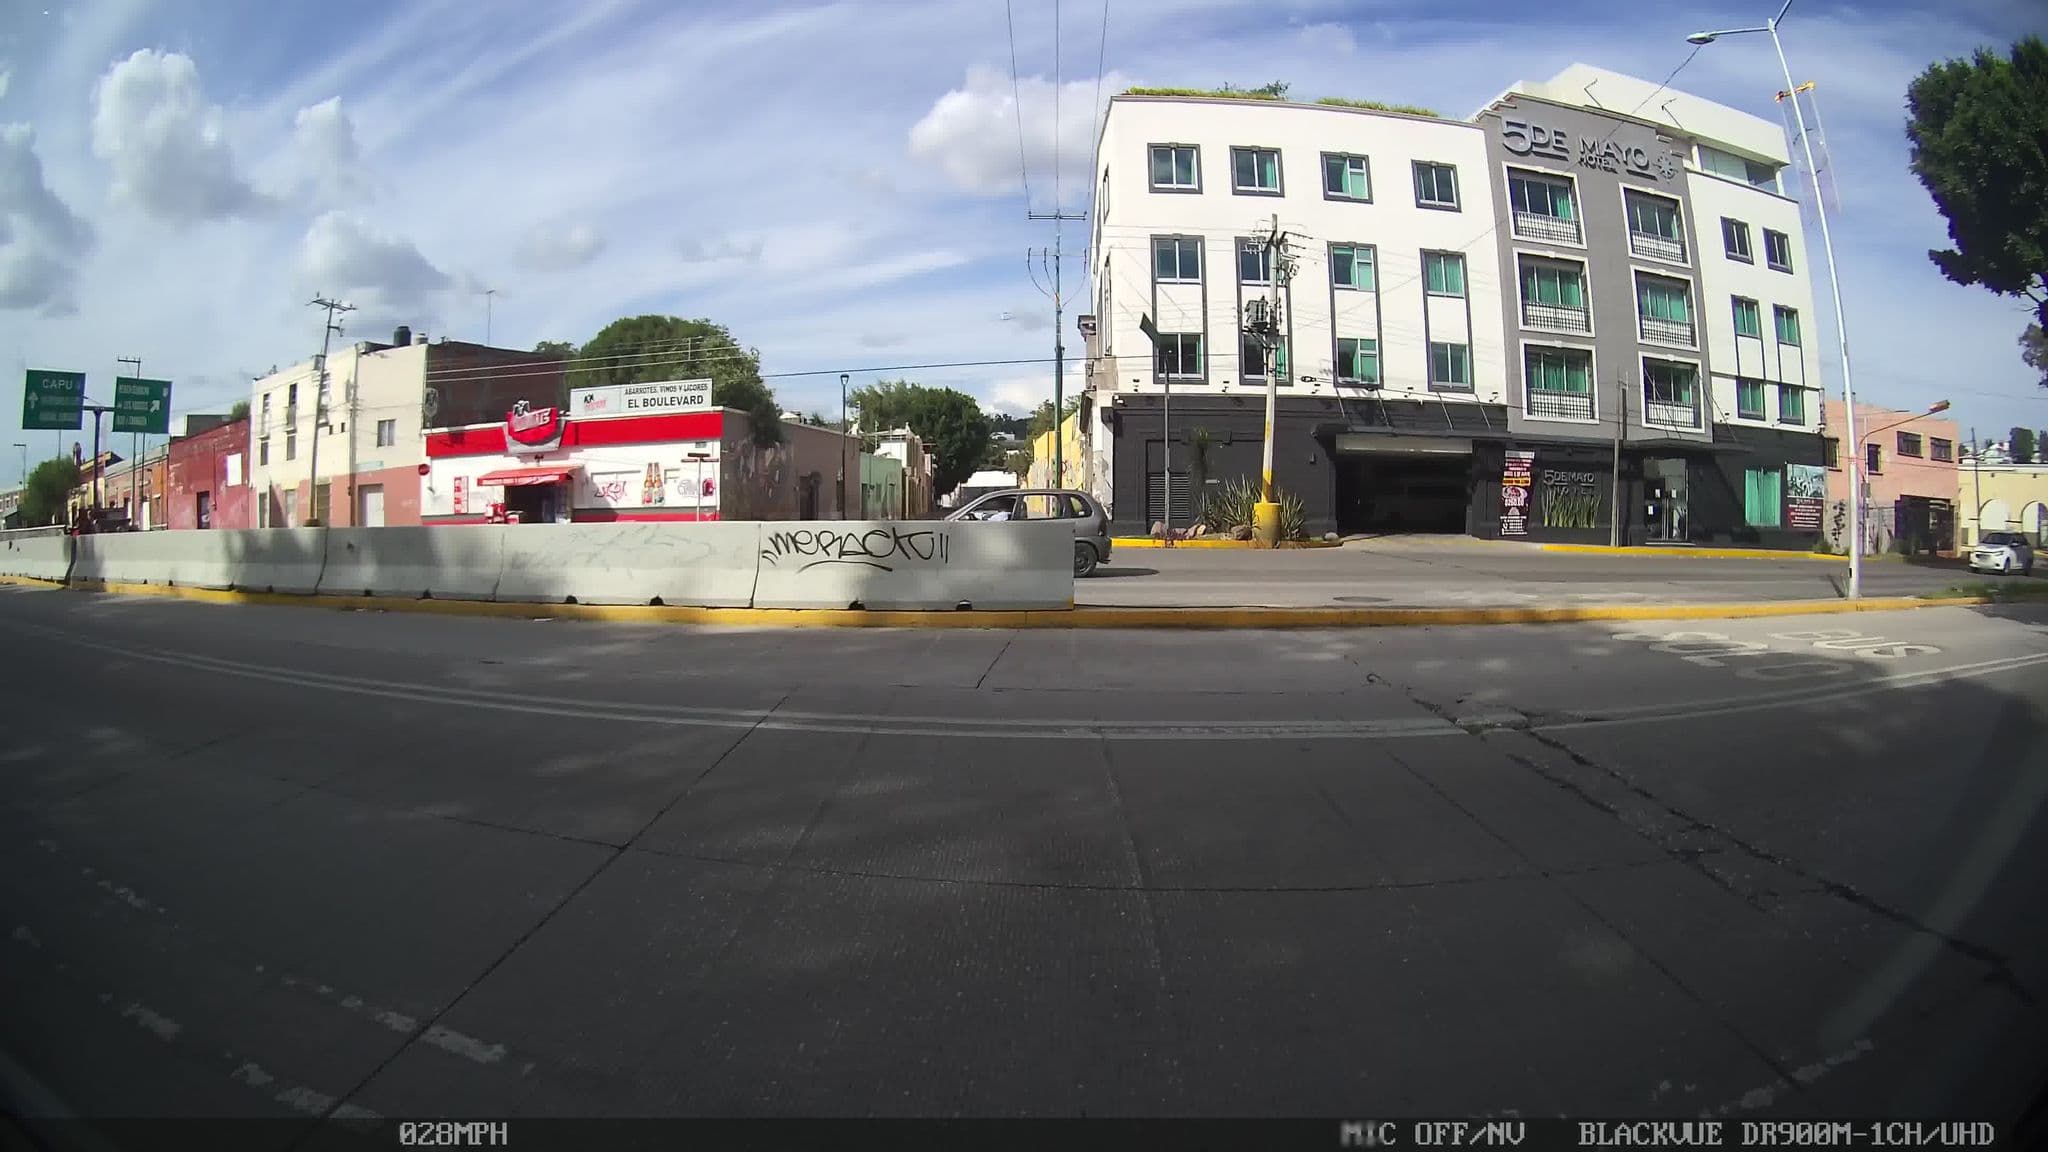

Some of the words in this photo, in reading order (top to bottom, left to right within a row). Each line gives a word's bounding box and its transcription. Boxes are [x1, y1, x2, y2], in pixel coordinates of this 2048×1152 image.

[1503, 119, 1532, 153] 5
[1531, 126, 1569, 154] DE
[1580, 137, 1650, 170] MAYO
[1578, 155, 1618, 174] HOTEL
[42, 379, 73, 390] CAPU
[660, 384, 677, 393] VINOS
[684, 383, 709, 392] LICORES
[628, 399, 639, 408] EL
[643, 395, 704, 407] BOULEVARD
